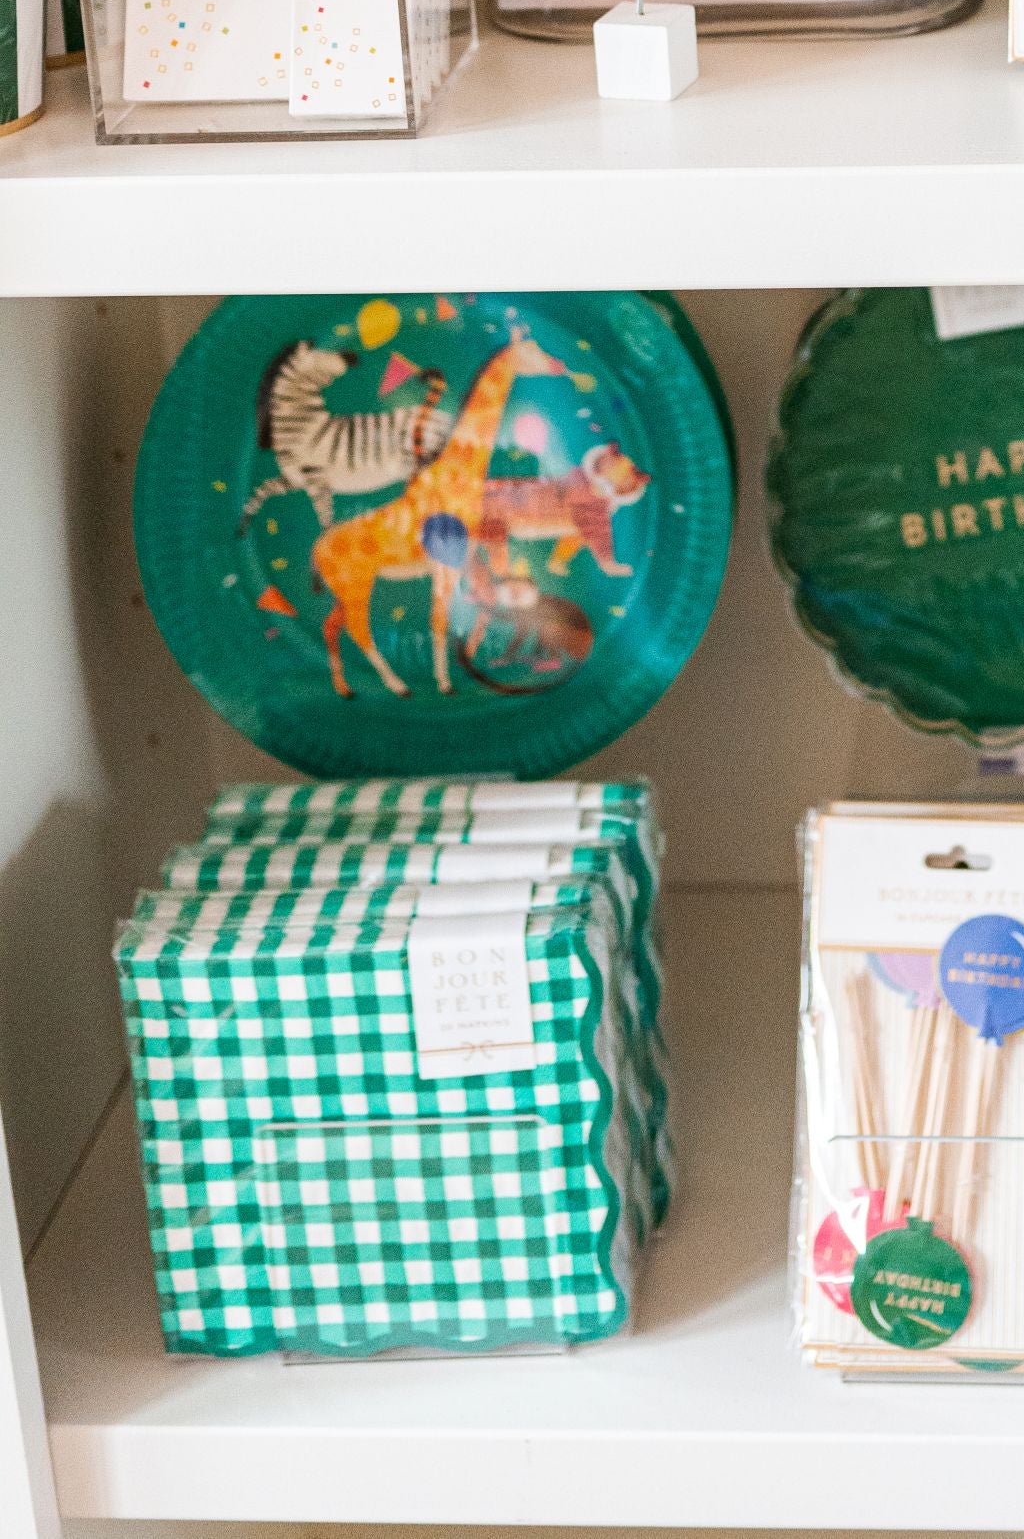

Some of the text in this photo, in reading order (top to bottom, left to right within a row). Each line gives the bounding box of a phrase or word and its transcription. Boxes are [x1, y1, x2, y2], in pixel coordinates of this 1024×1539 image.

[431, 947, 505, 968] BON
[963, 951, 1022, 968] HAPPY
[433, 970, 508, 990] JOUR
[434, 993, 511, 1014] FÊTE
[873, 1270, 962, 1298] BIRTHDAY
[884, 1292, 946, 1315] HAPPY
